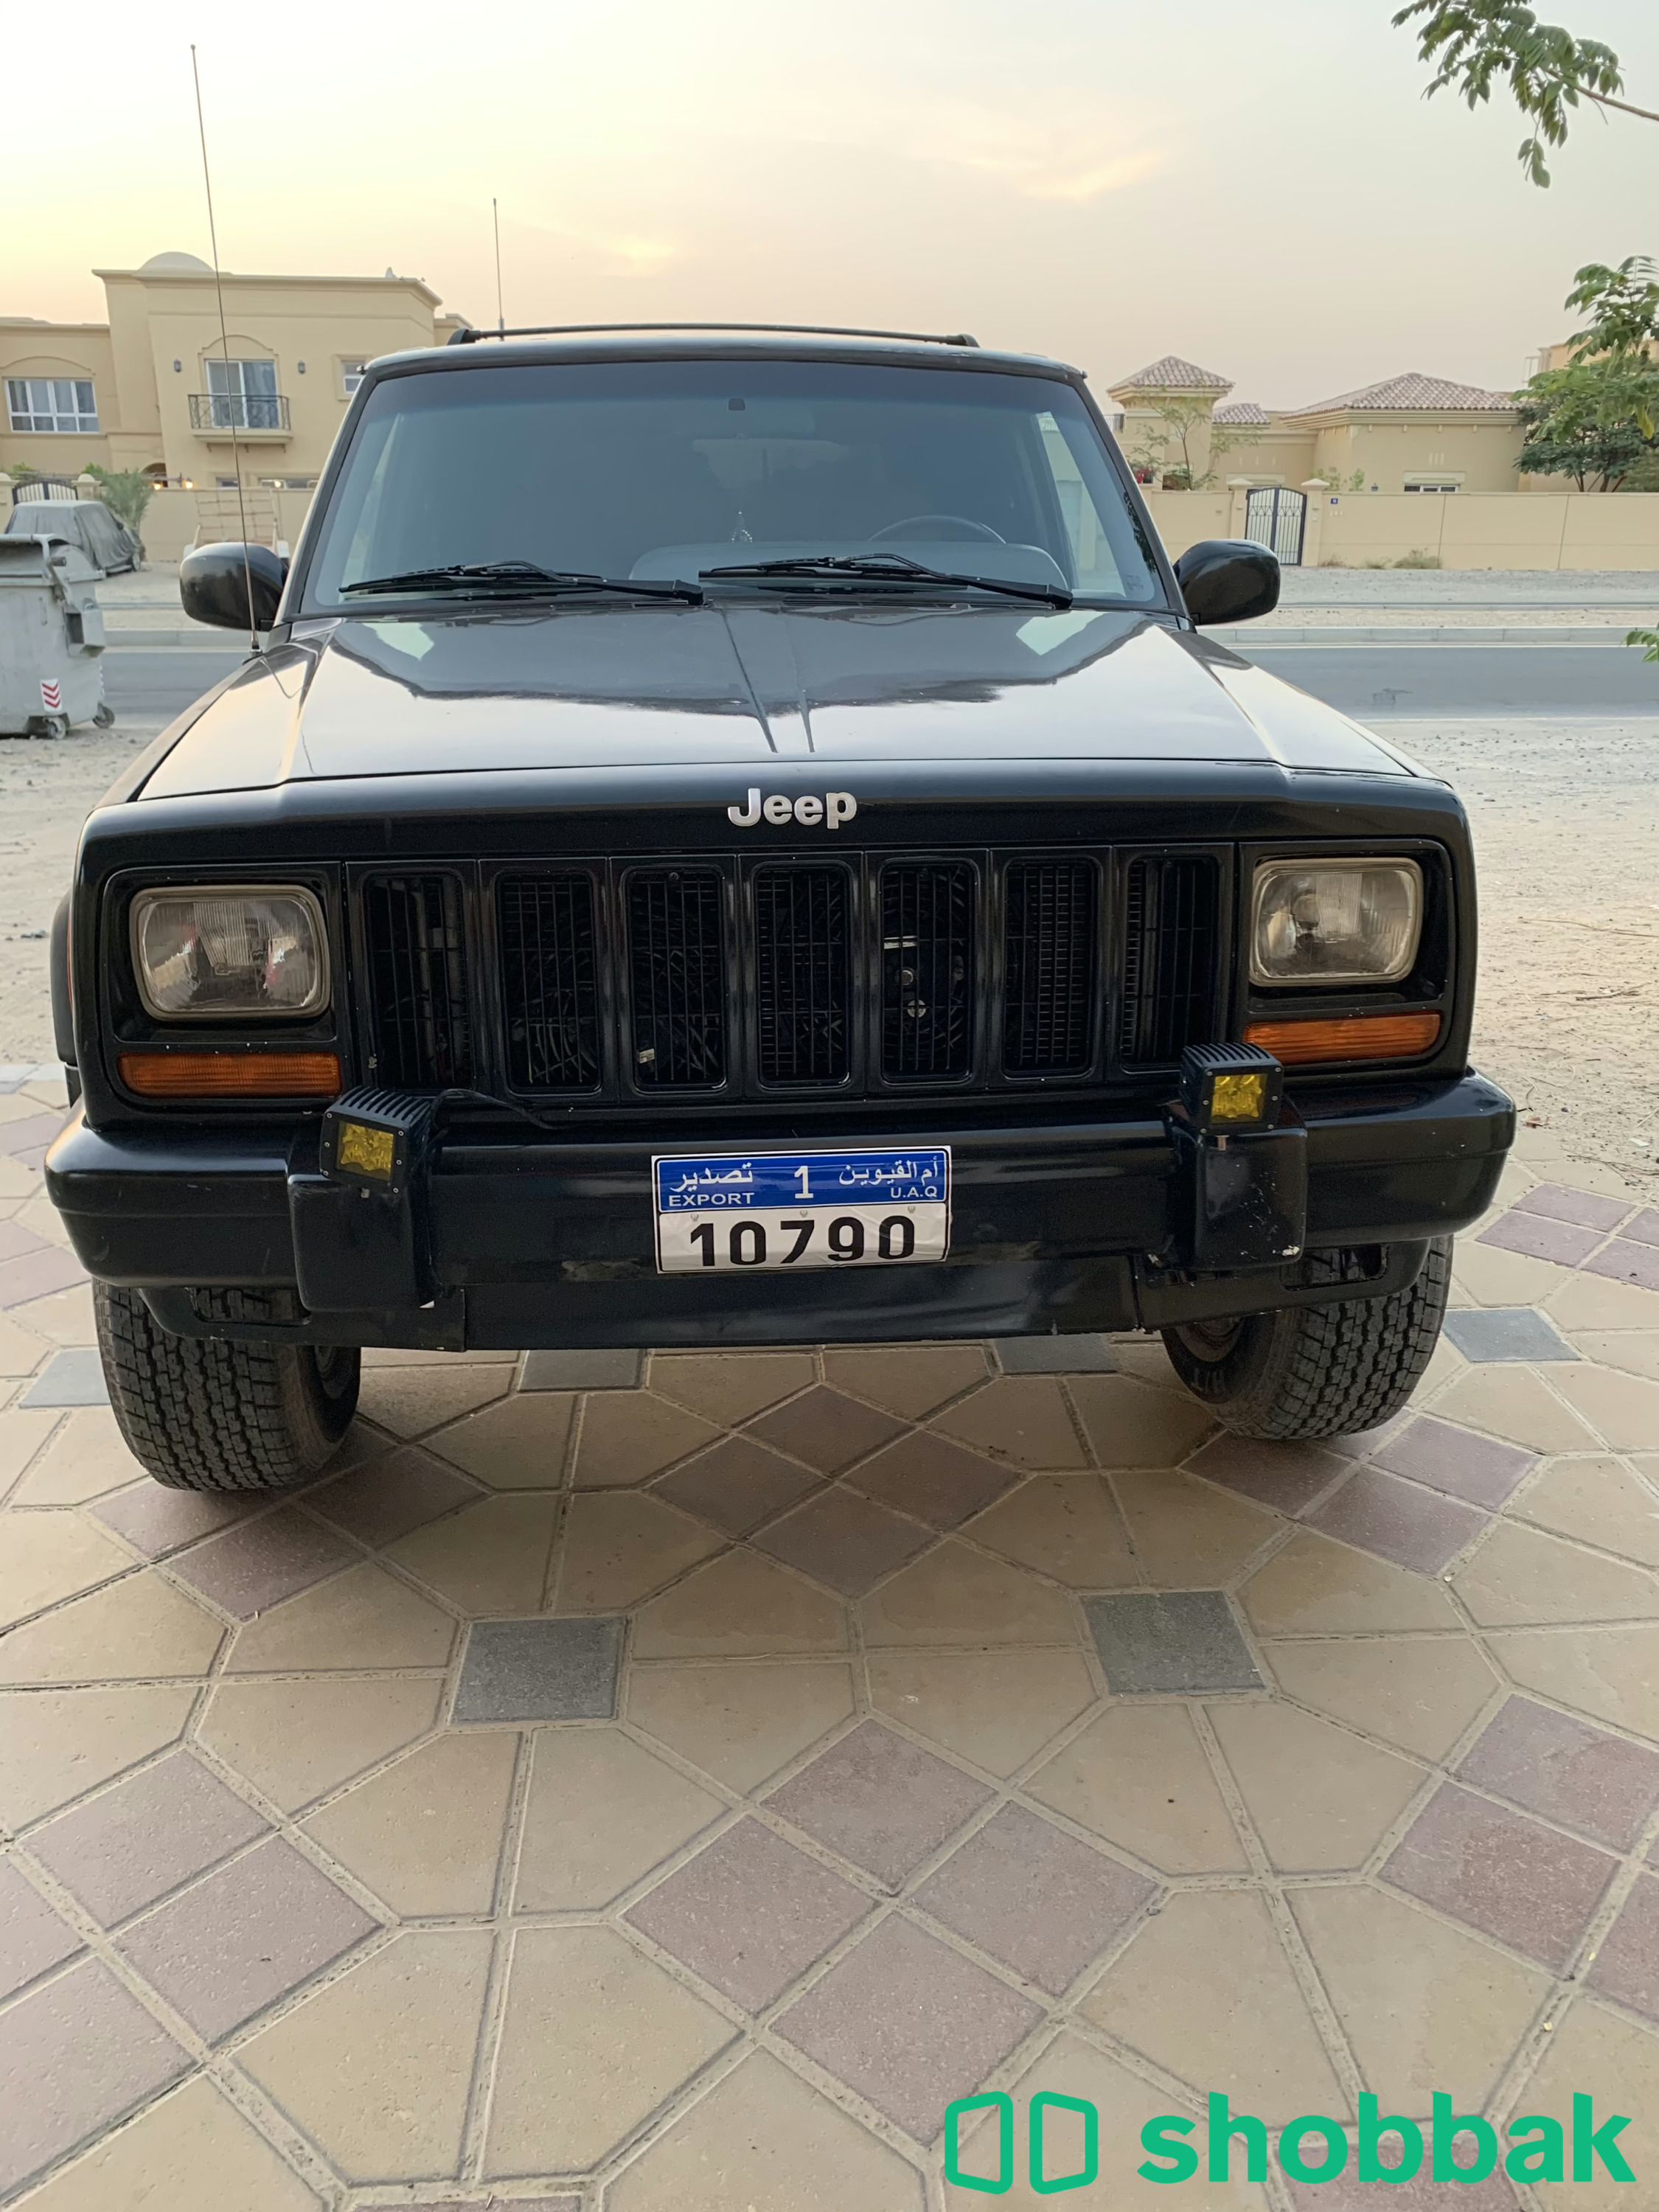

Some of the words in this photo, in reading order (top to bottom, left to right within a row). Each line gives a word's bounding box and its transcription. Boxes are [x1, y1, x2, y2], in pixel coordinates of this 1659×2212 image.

[727, 787, 858, 830] Jeep
[669, 1162, 754, 1193] تصدير
[793, 1164, 815, 1200] 1
[838, 1159, 917, 1186] القيوين
[921, 1155, 938, 1186] أم
[668, 1192, 755, 1207] EXPORT
[890, 1185, 938, 1199] U.A.Q
[689, 1214, 916, 1267] 10790
